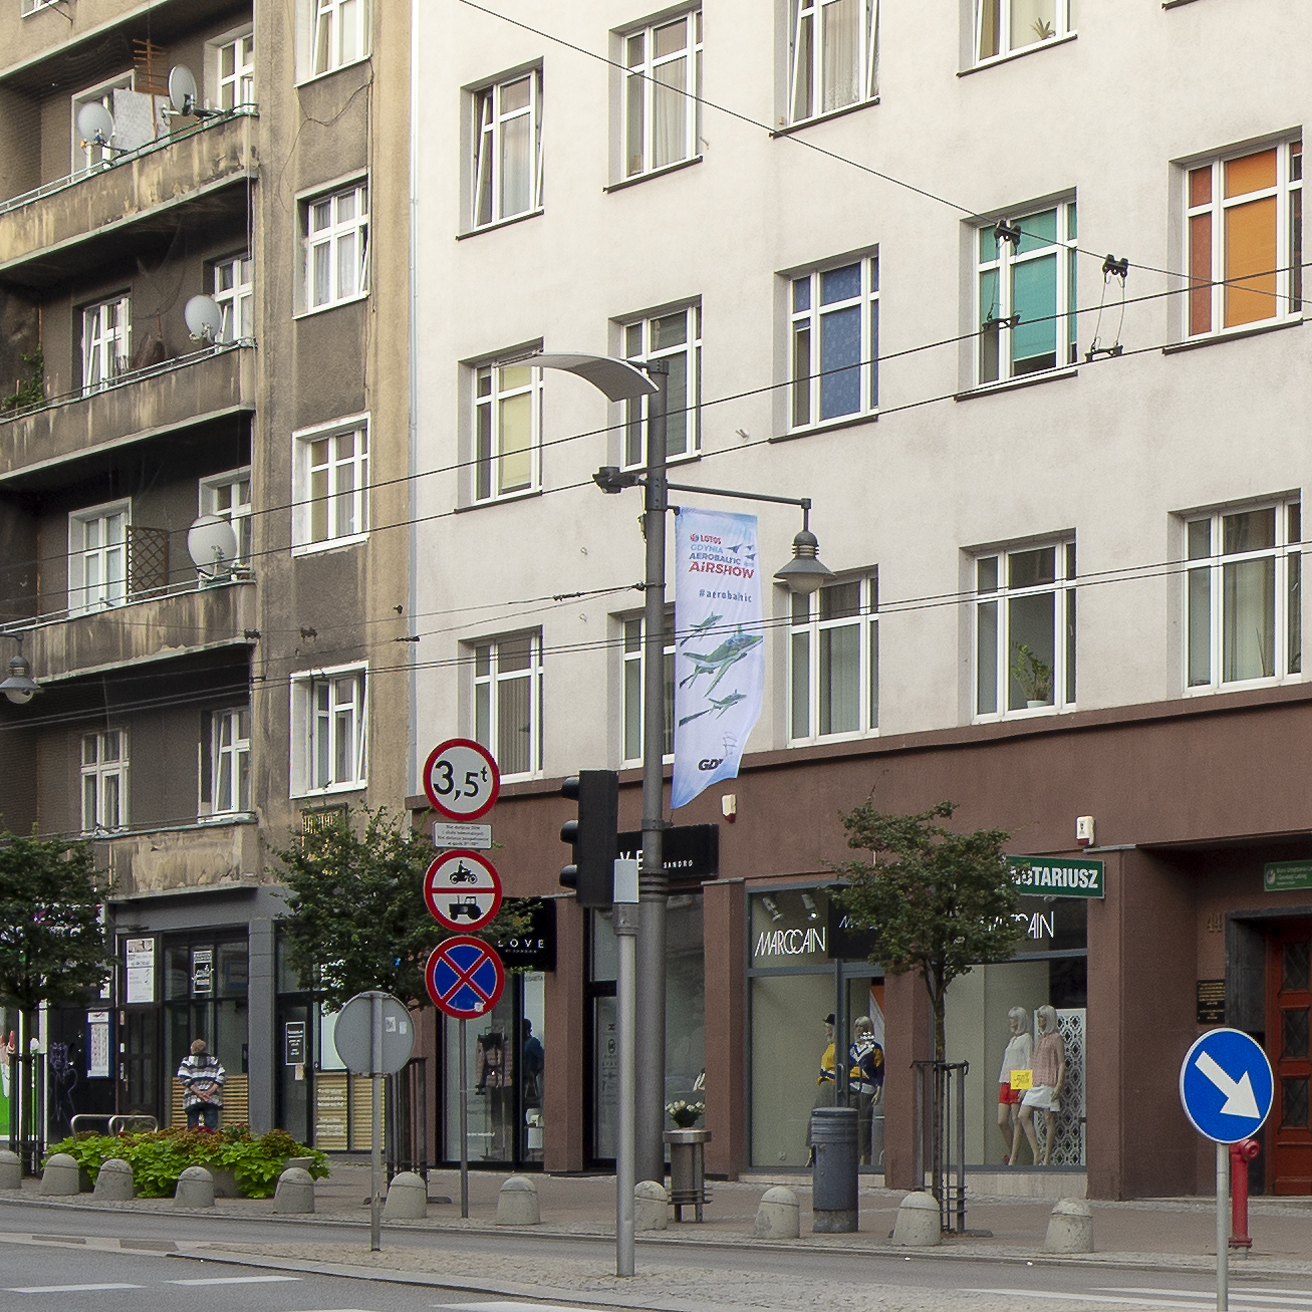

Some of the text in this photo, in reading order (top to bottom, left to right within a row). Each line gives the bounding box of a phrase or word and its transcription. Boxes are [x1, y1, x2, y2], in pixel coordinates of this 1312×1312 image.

[690, 543, 724, 554] GDYNIA
[689, 552, 742, 565] AEROBALTIC
[698, 758, 724, 771] GD
